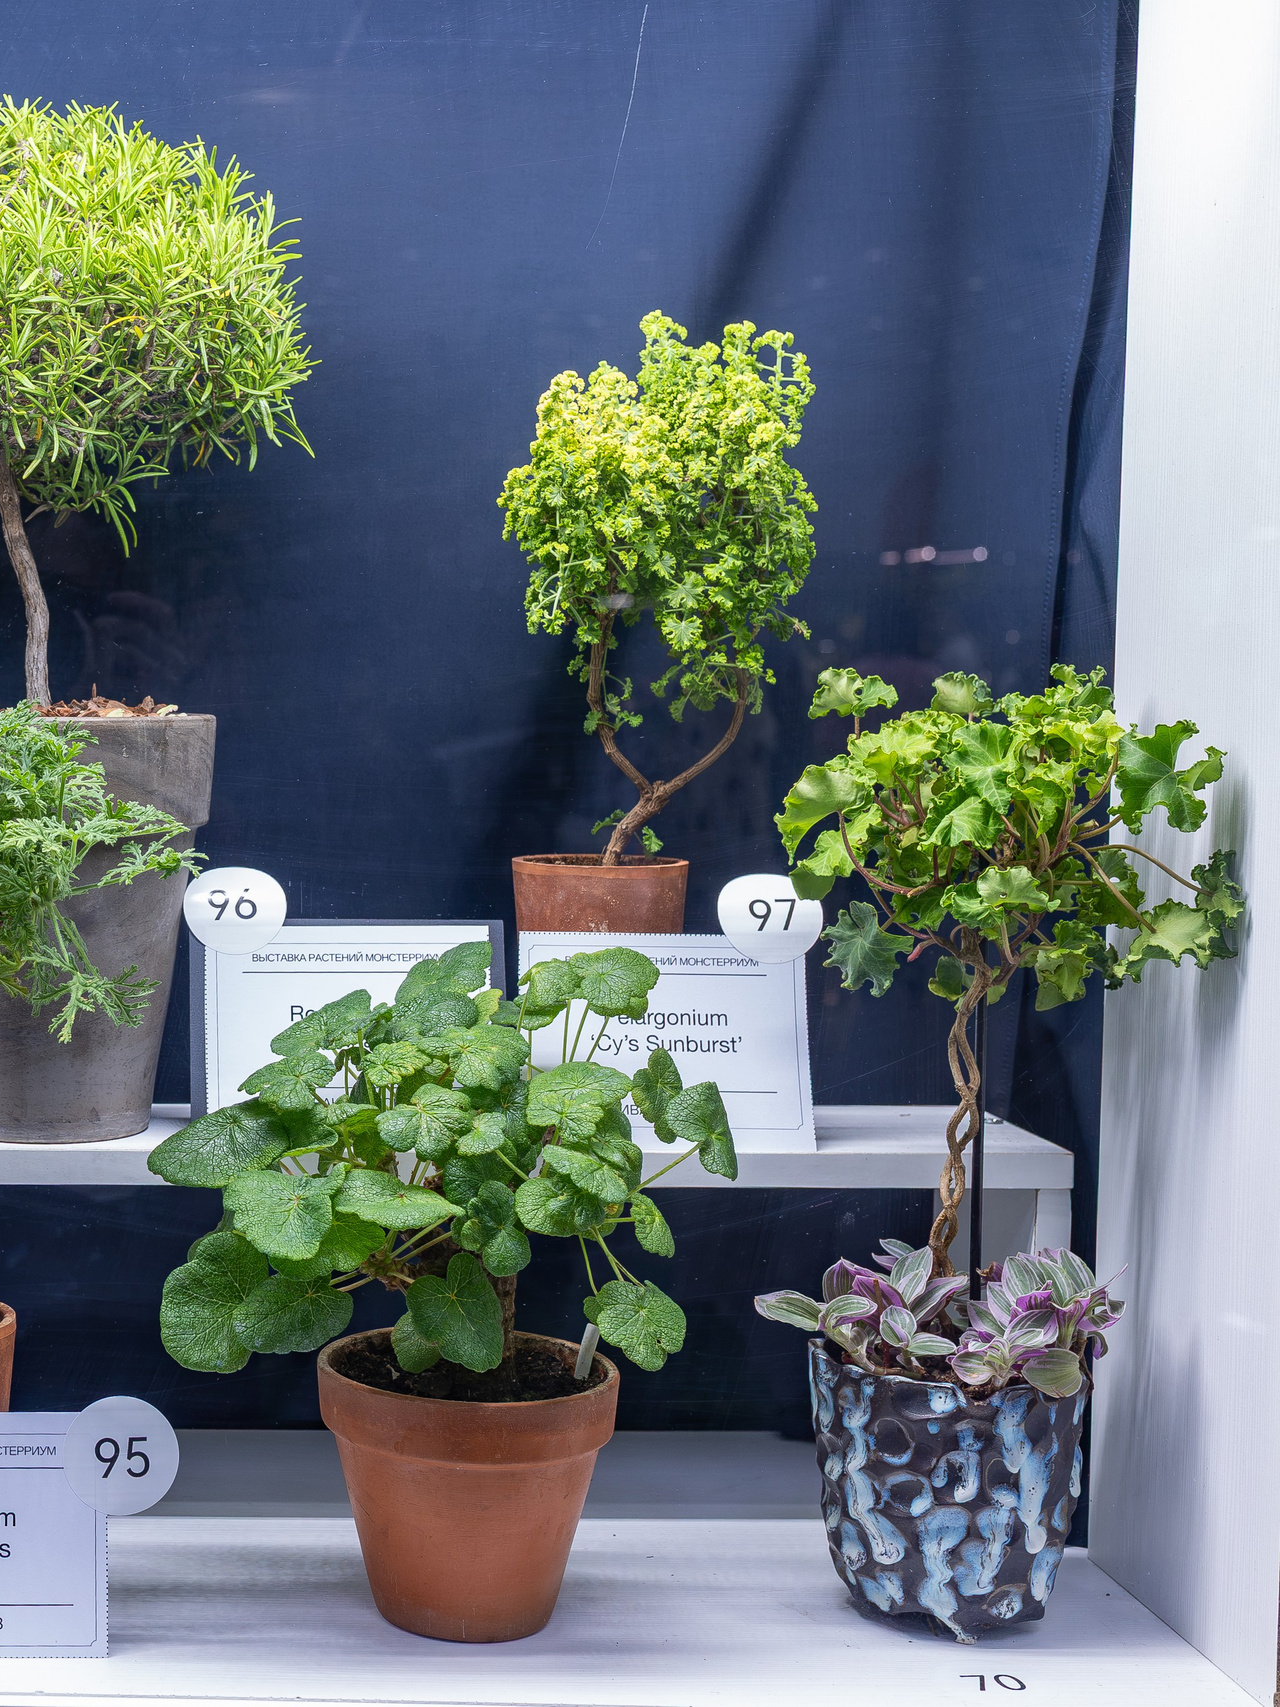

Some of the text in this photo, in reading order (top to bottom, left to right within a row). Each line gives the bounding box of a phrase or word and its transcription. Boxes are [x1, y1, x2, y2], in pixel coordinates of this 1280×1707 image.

[207, 888, 258, 921] 96
[748, 898, 797, 932] 97
[251, 953, 307, 963] ВЫСТАВКА
[308, 951, 364, 963] РАСТЕНИЙ
[679, 957, 759, 967] МОНСТЕРРИУМ
[590, 1033, 742, 1056] ‘Cy’s Sunburst’
[94, 1436, 151, 1479] 95
[959, 1674, 1027, 1692] 70
